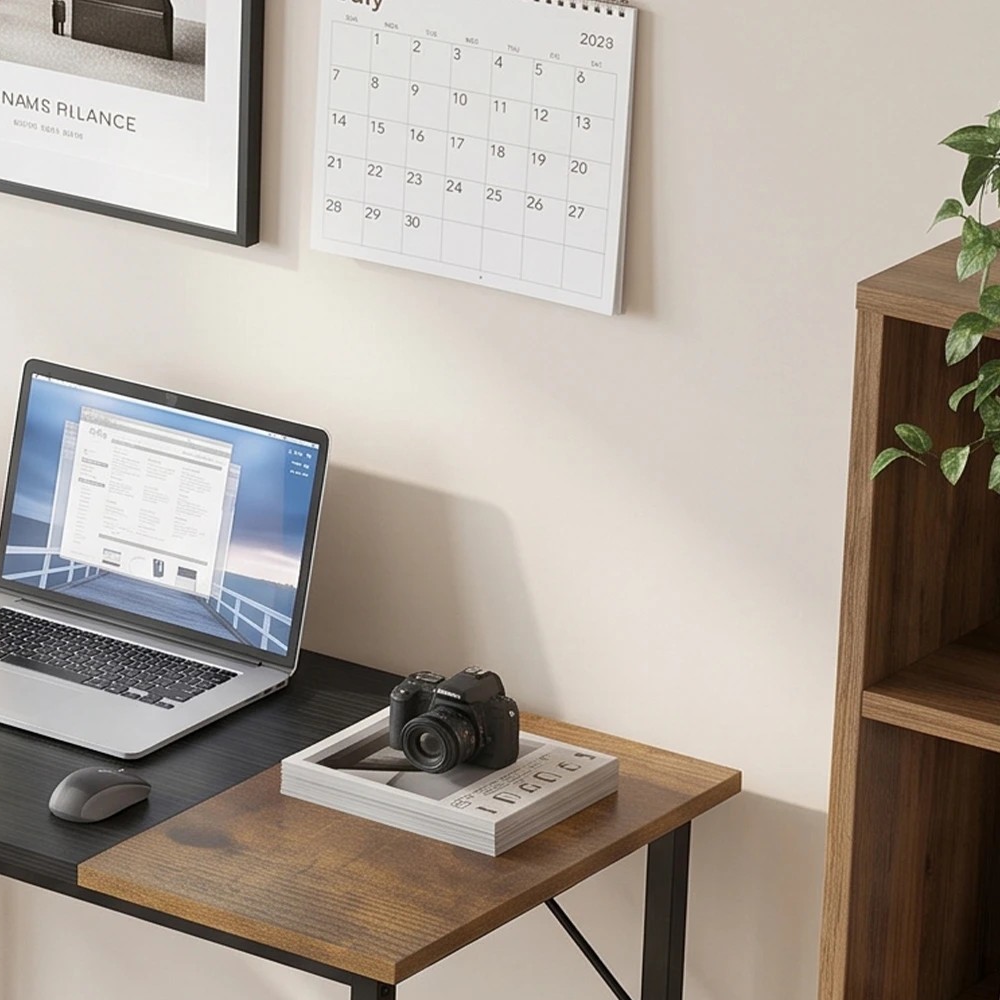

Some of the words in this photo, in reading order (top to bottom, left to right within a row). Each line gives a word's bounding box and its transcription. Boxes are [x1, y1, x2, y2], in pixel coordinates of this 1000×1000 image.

[374, 33, 380, 45] 1
[412, 39, 421, 53] 2
[453, 47, 461, 61] 3
[494, 55, 503, 69] 4
[535, 62, 543, 76] 5
[576, 71, 586, 84] 6
[1, 90, 51, 114] NAMS
[332, 68, 341, 81] 7
[370, 76, 380, 90] 8
[410, 83, 420, 97] 9
[452, 92, 468, 106] 10
[493, 100, 507, 114] 11
[533, 108, 549, 122] 12
[575, 115, 591, 130] 13
[331, 112, 347, 127] 14
[370, 120, 385, 135] 15
[409, 128, 425, 142] 16
[449, 136, 465, 149] 17
[490, 144, 506, 159] 18
[531, 152, 547, 166] 19
[570, 160, 588, 175] 20
[325, 198, 342, 213] 28
[364, 206, 381, 220] 29
[404, 214, 421, 229] 30
[327, 155, 342, 169] 21
[367, 163, 383, 178] 22
[406, 171, 423, 186] 23
[446, 179, 463, 194] 24
[486, 187, 503, 202] 25
[526, 195, 544, 211] 26
[568, 204, 585, 219] 27
